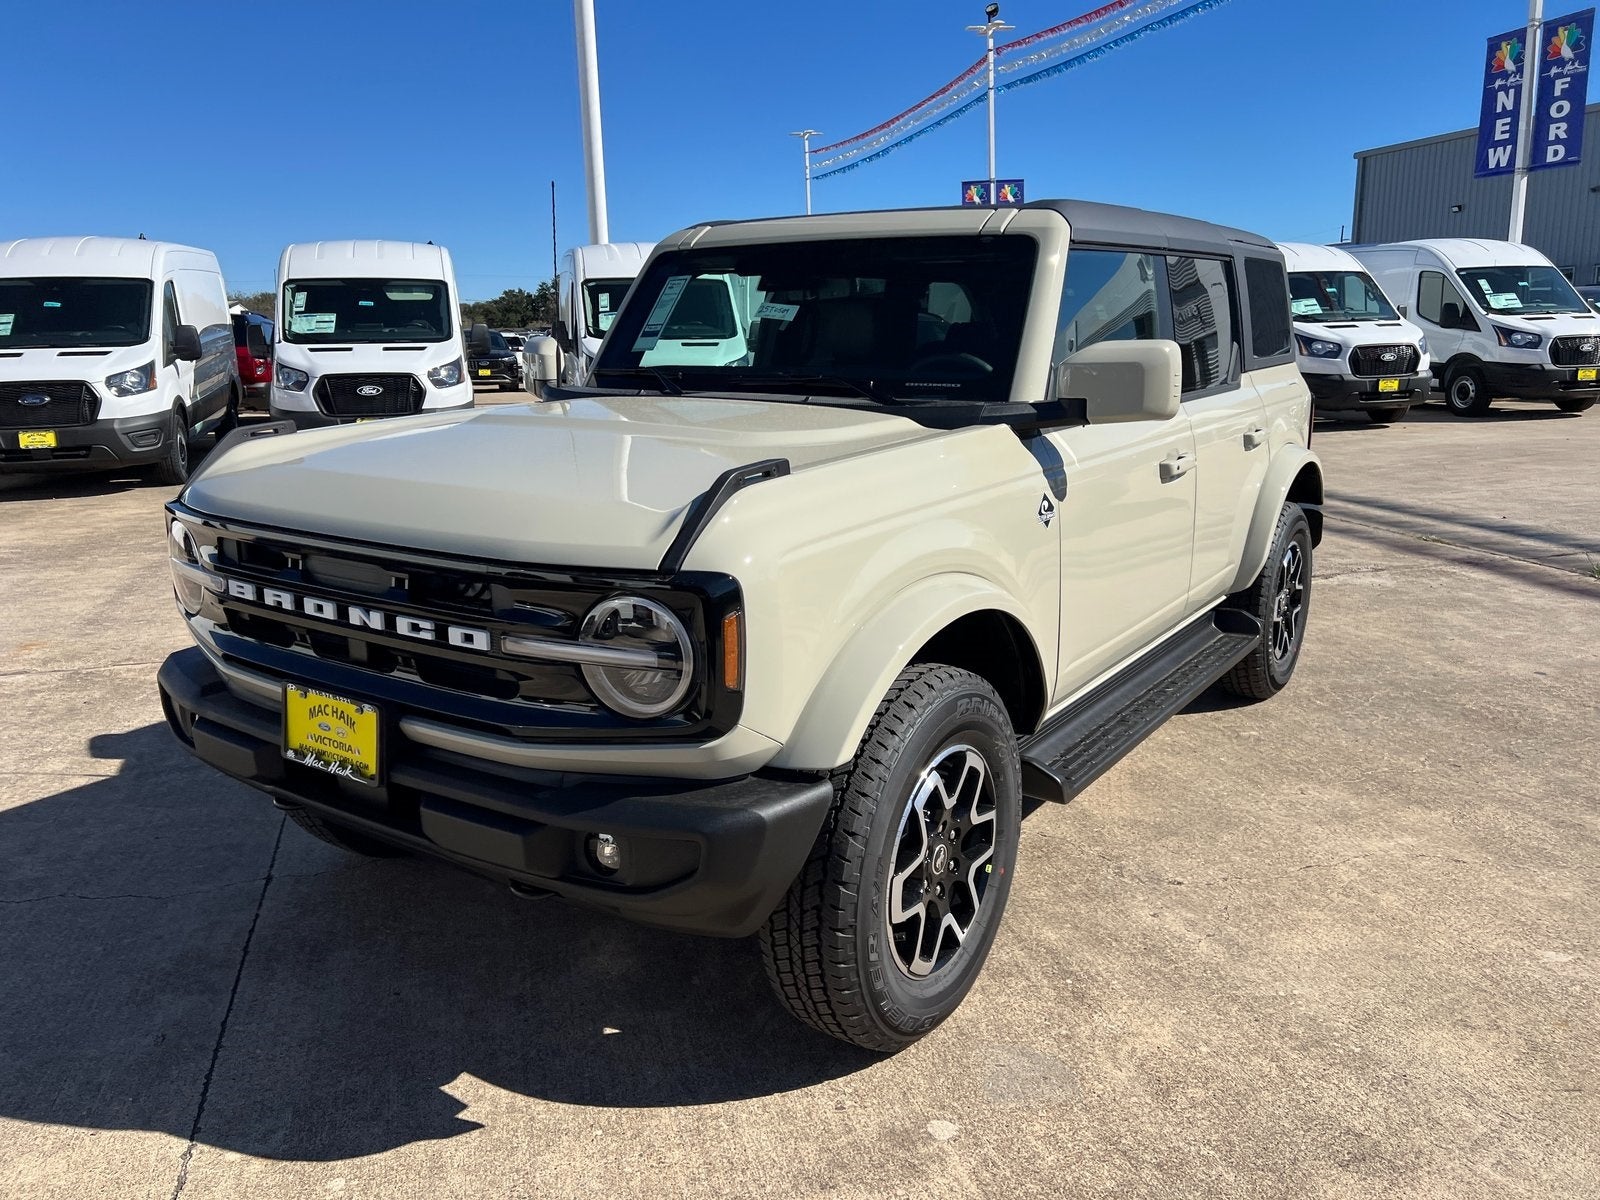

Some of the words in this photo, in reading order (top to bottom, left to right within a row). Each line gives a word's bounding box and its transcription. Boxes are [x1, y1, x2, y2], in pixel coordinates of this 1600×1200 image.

[1488, 88, 1515, 169] NEW
[1545, 77, 1571, 163] FORD
[361, 386, 377, 394] Ford
[228, 579, 491, 651] BRONCO
[308, 704, 330, 720] MAC
[331, 706, 357, 734] HAIK
[313, 733, 353, 753] VICTORIA
[301, 752, 328, 770] Mac
[328, 761, 361, 782] Haik
